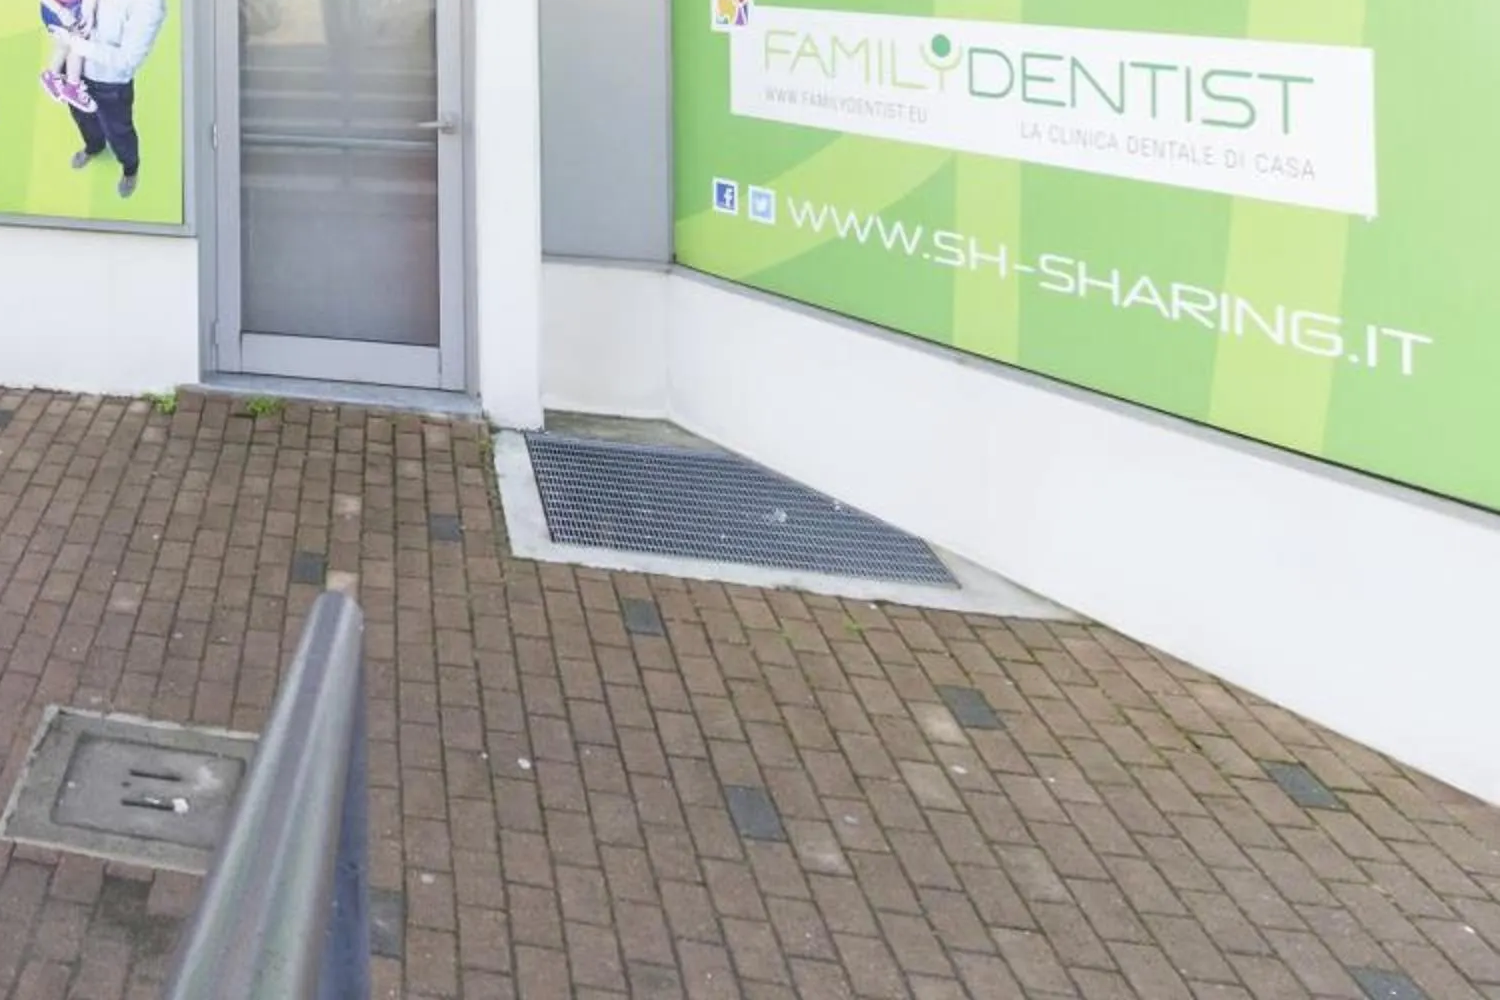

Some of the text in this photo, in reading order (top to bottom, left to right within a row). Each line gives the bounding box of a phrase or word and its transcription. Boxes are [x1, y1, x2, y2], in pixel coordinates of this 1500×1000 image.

[1020, 120, 1316, 182] LA CLINICA DENTALE DI CASA
[786, 196, 1433, 376] WWW.SH-SHARING.IT
